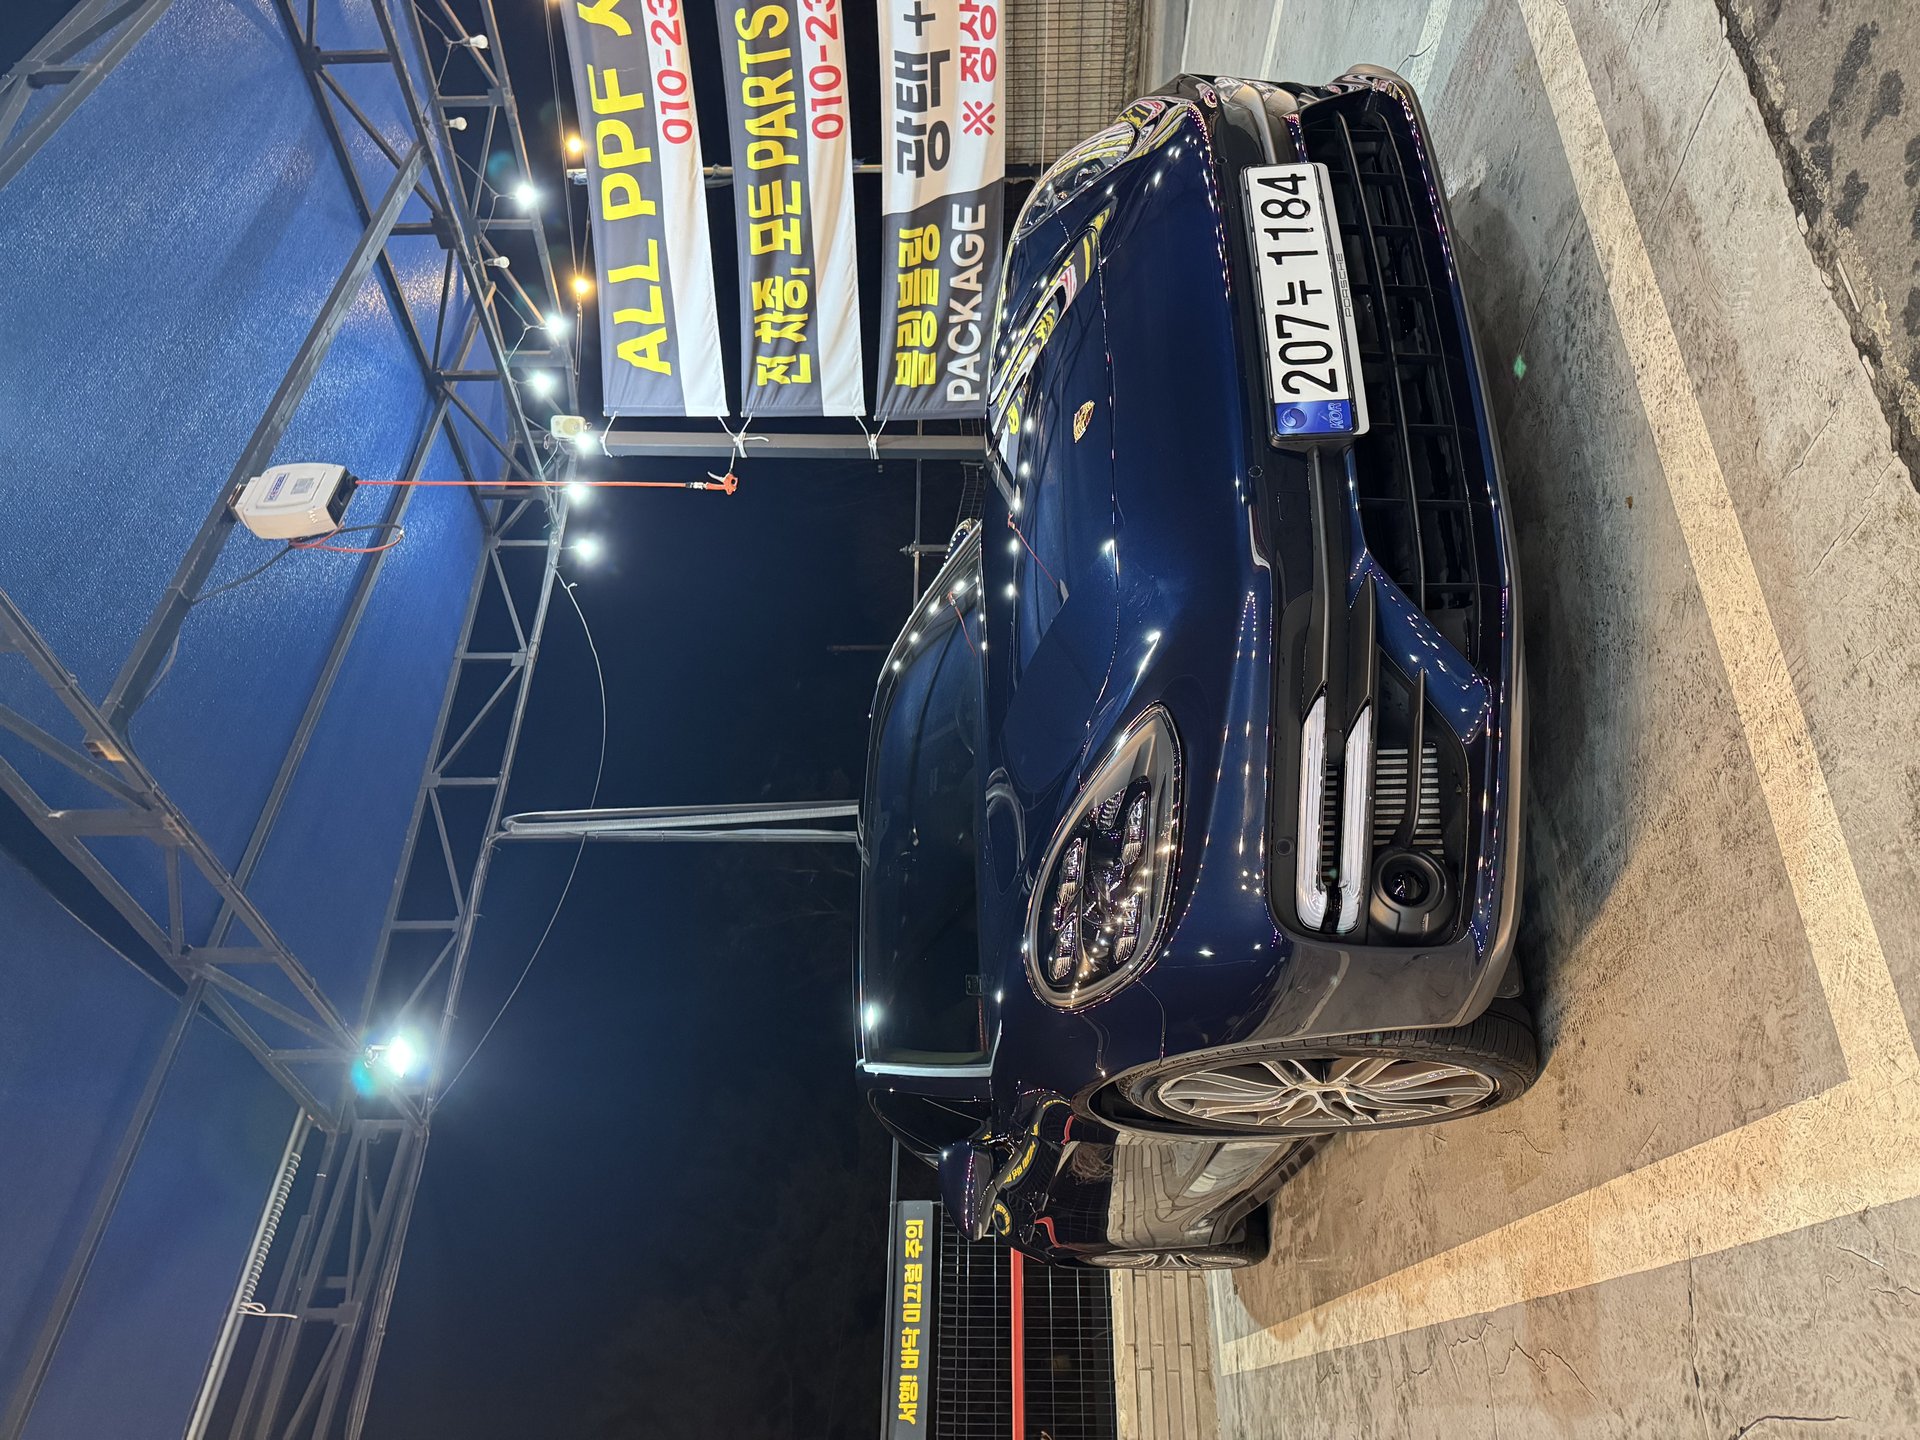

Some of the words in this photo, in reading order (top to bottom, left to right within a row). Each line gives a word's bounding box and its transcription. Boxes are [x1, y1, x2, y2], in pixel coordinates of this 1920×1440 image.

[959, 0, 997, 83] 정상
[734, 5, 799, 171] PARTS
[894, 48, 951, 179] 광택
[587, 63, 656, 221] PPF
[748, 179, 802, 255] 모든
[1257, 173, 1319, 266] 1184
[608, 238, 671, 376] ALL
[752, 268, 810, 343] 차종,
[895, 223, 942, 388] 블링블링
[947, 203, 986, 402] PACKAGE
[1336, 252, 1352, 318] PORSCHE
[755, 353, 811, 385] 전
[1328, 402, 1344, 429] KOR
[905, 1220, 925, 1259] 주의
[903, 1264, 923, 1322] 미끄럼
[901, 1327, 921, 1370] 바닥
[898, 1375, 919, 1425] 서행!
